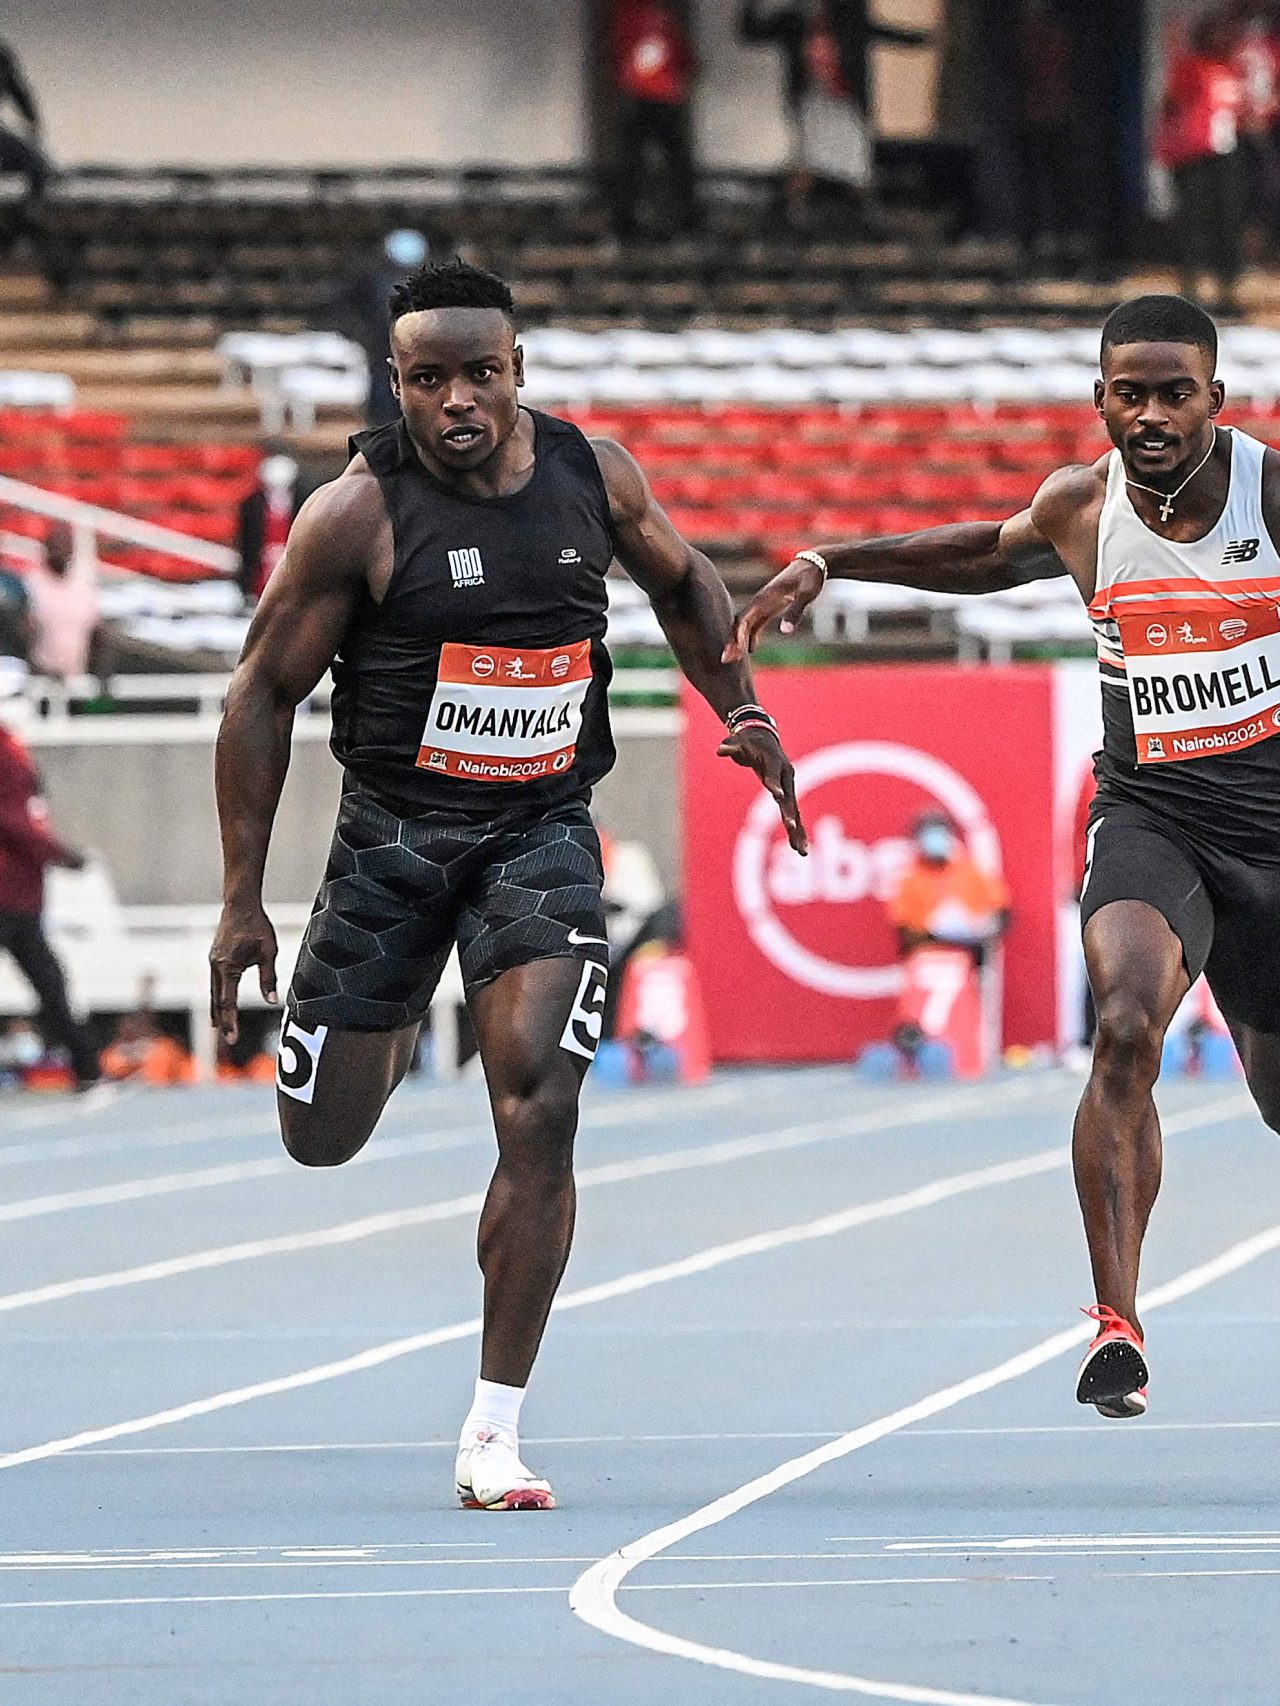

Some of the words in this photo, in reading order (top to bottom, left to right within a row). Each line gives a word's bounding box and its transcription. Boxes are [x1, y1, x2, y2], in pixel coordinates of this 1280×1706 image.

[453, 577, 486, 588] AFRICA
[435, 701, 571, 739] OMANYALA
[1172, 720, 1267, 754] Nairobi2021
[457, 758, 547, 777] Nairobi2021
[572, 966, 606, 1052] 5
[912, 951, 968, 1034] 7
[279, 1014, 317, 1088] 5
